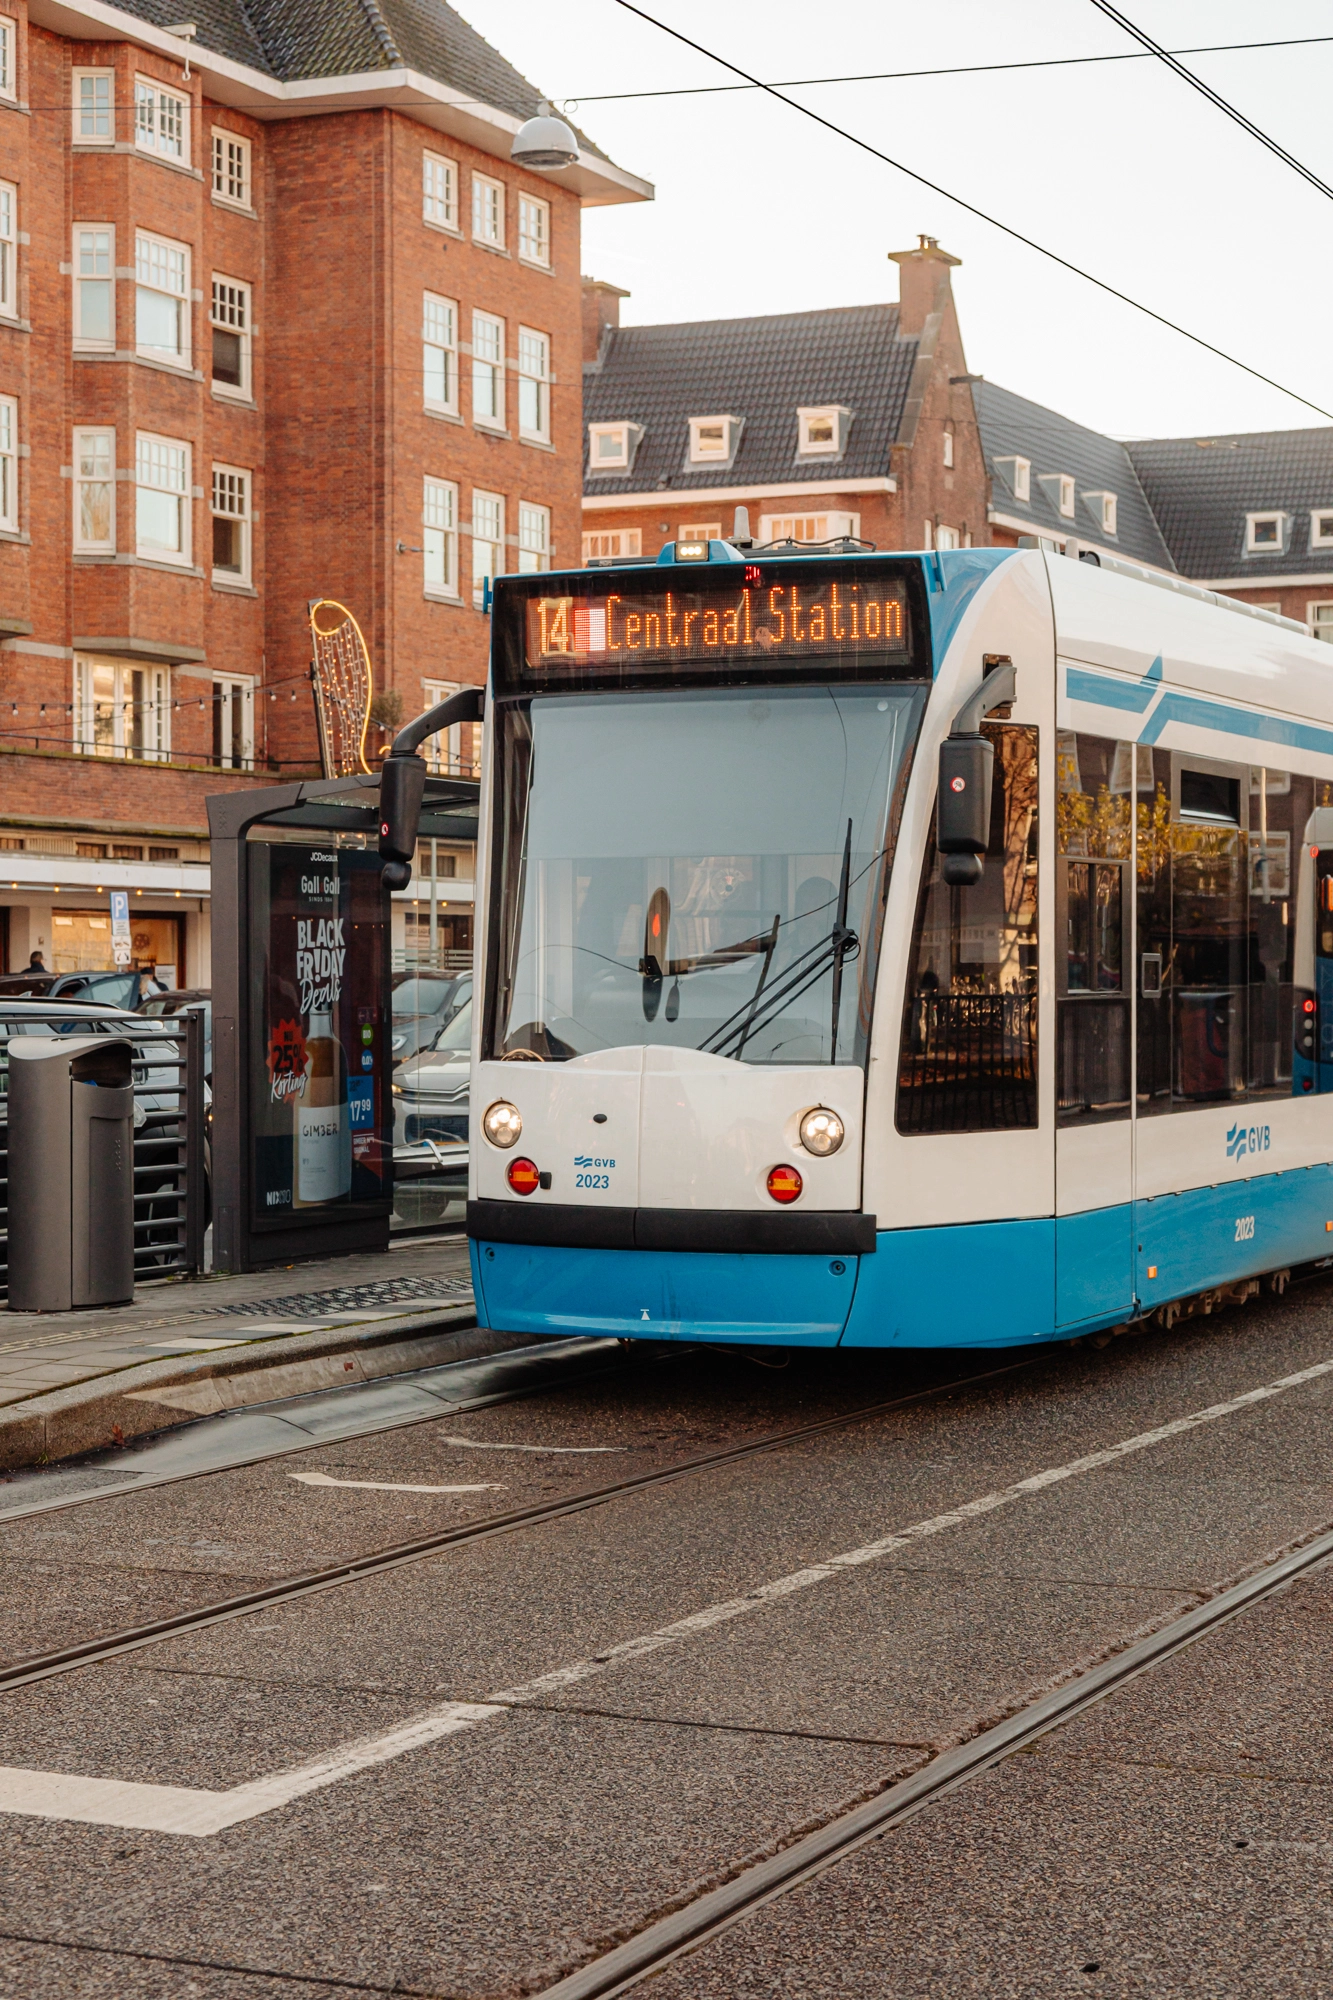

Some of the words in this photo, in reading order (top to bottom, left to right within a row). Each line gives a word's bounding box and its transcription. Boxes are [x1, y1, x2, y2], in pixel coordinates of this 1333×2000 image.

[537, 600, 568, 653] 14
[607, 589, 753, 649] Centraal
[769, 583, 901, 643] Station
[310, 852, 338, 862] JCDecaux
[301, 875, 320, 894] Gall
[323, 876, 340, 895] Gall
[115, 896, 124, 918] P
[297, 918, 345, 949] BLACK
[300, 975, 342, 1015] Deals
[274, 1044, 304, 1075] 25%
[271, 1070, 308, 1104] Korting
[1248, 1125, 1271, 1153] GVB
[594, 1158, 616, 1168] GVB
[575, 1173, 610, 1190] 2023
[1234, 1215, 1255, 1242] 2023
